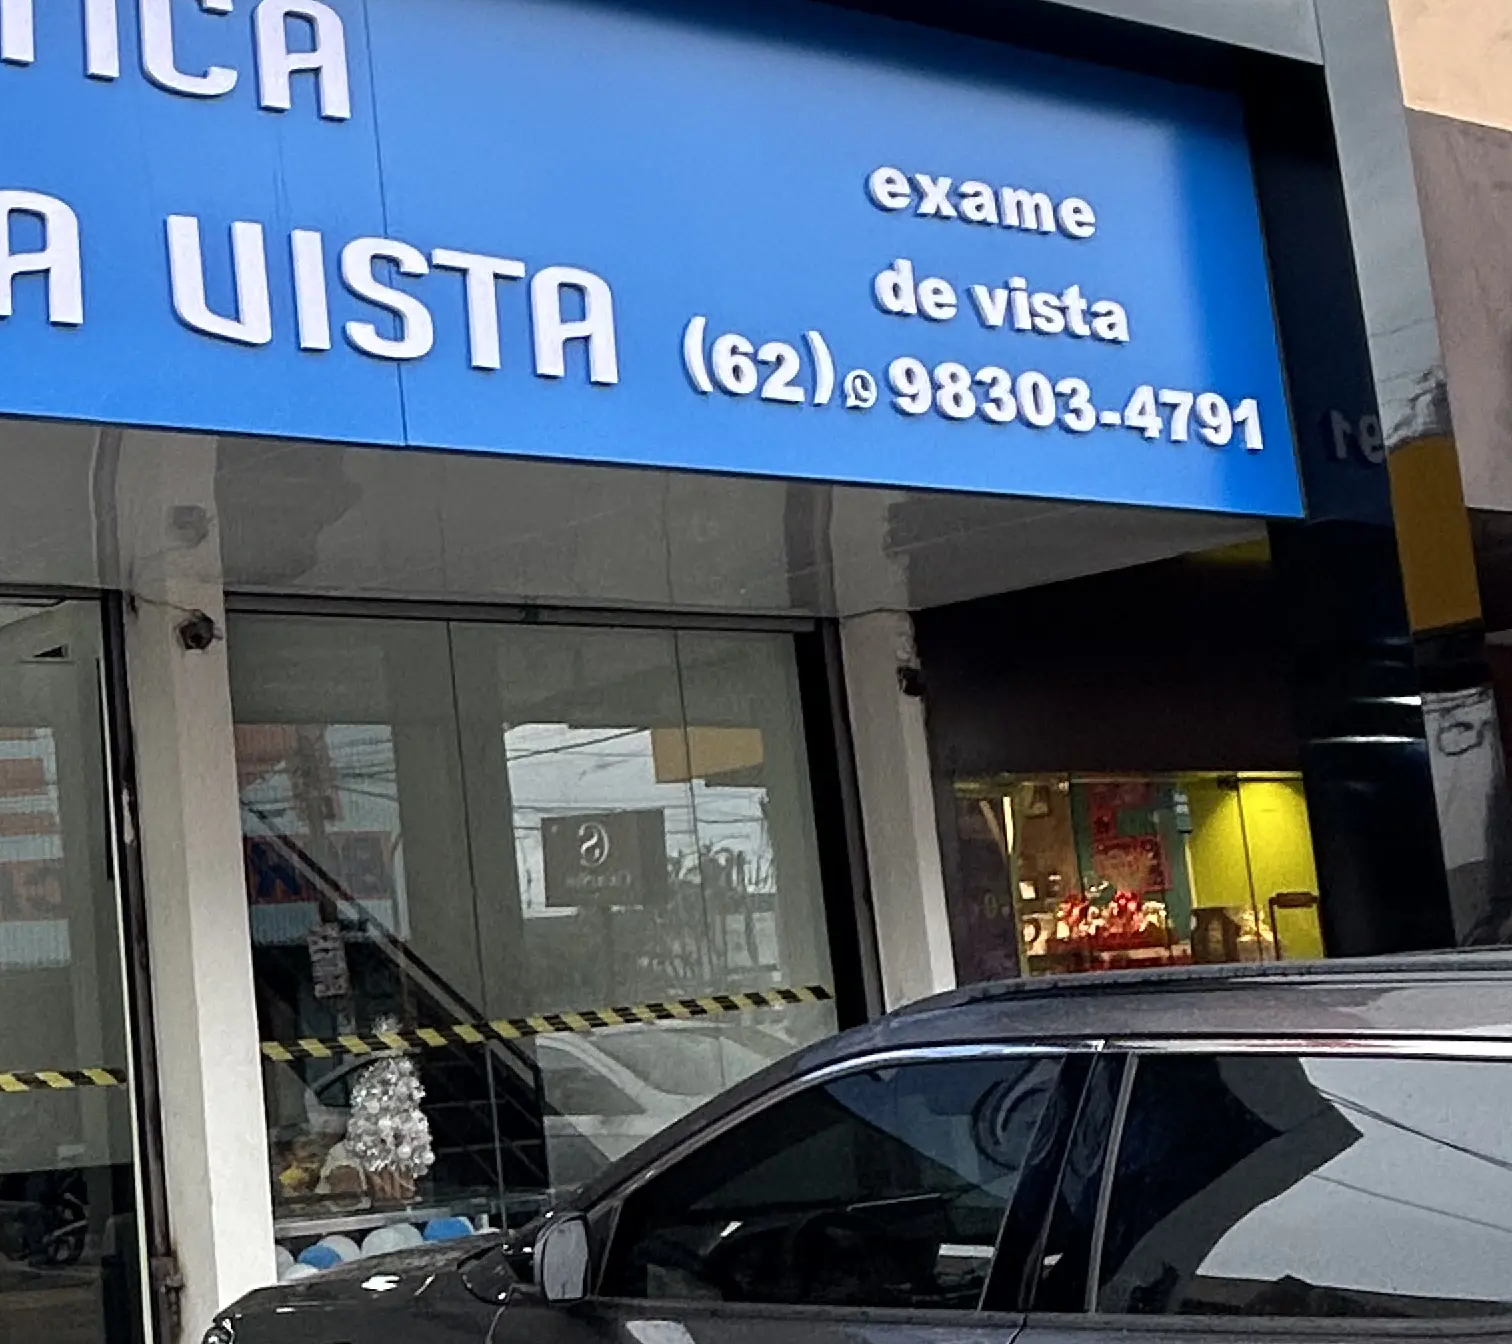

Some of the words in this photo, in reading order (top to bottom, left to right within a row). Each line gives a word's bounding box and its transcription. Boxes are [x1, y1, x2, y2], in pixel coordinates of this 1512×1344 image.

[866, 164, 1097, 239] exame
[873, 257, 958, 321] de
[970, 274, 1131, 343] vista
[683, 315, 836, 406] (62)
[887, 355, 1265, 451] 98303-4791
